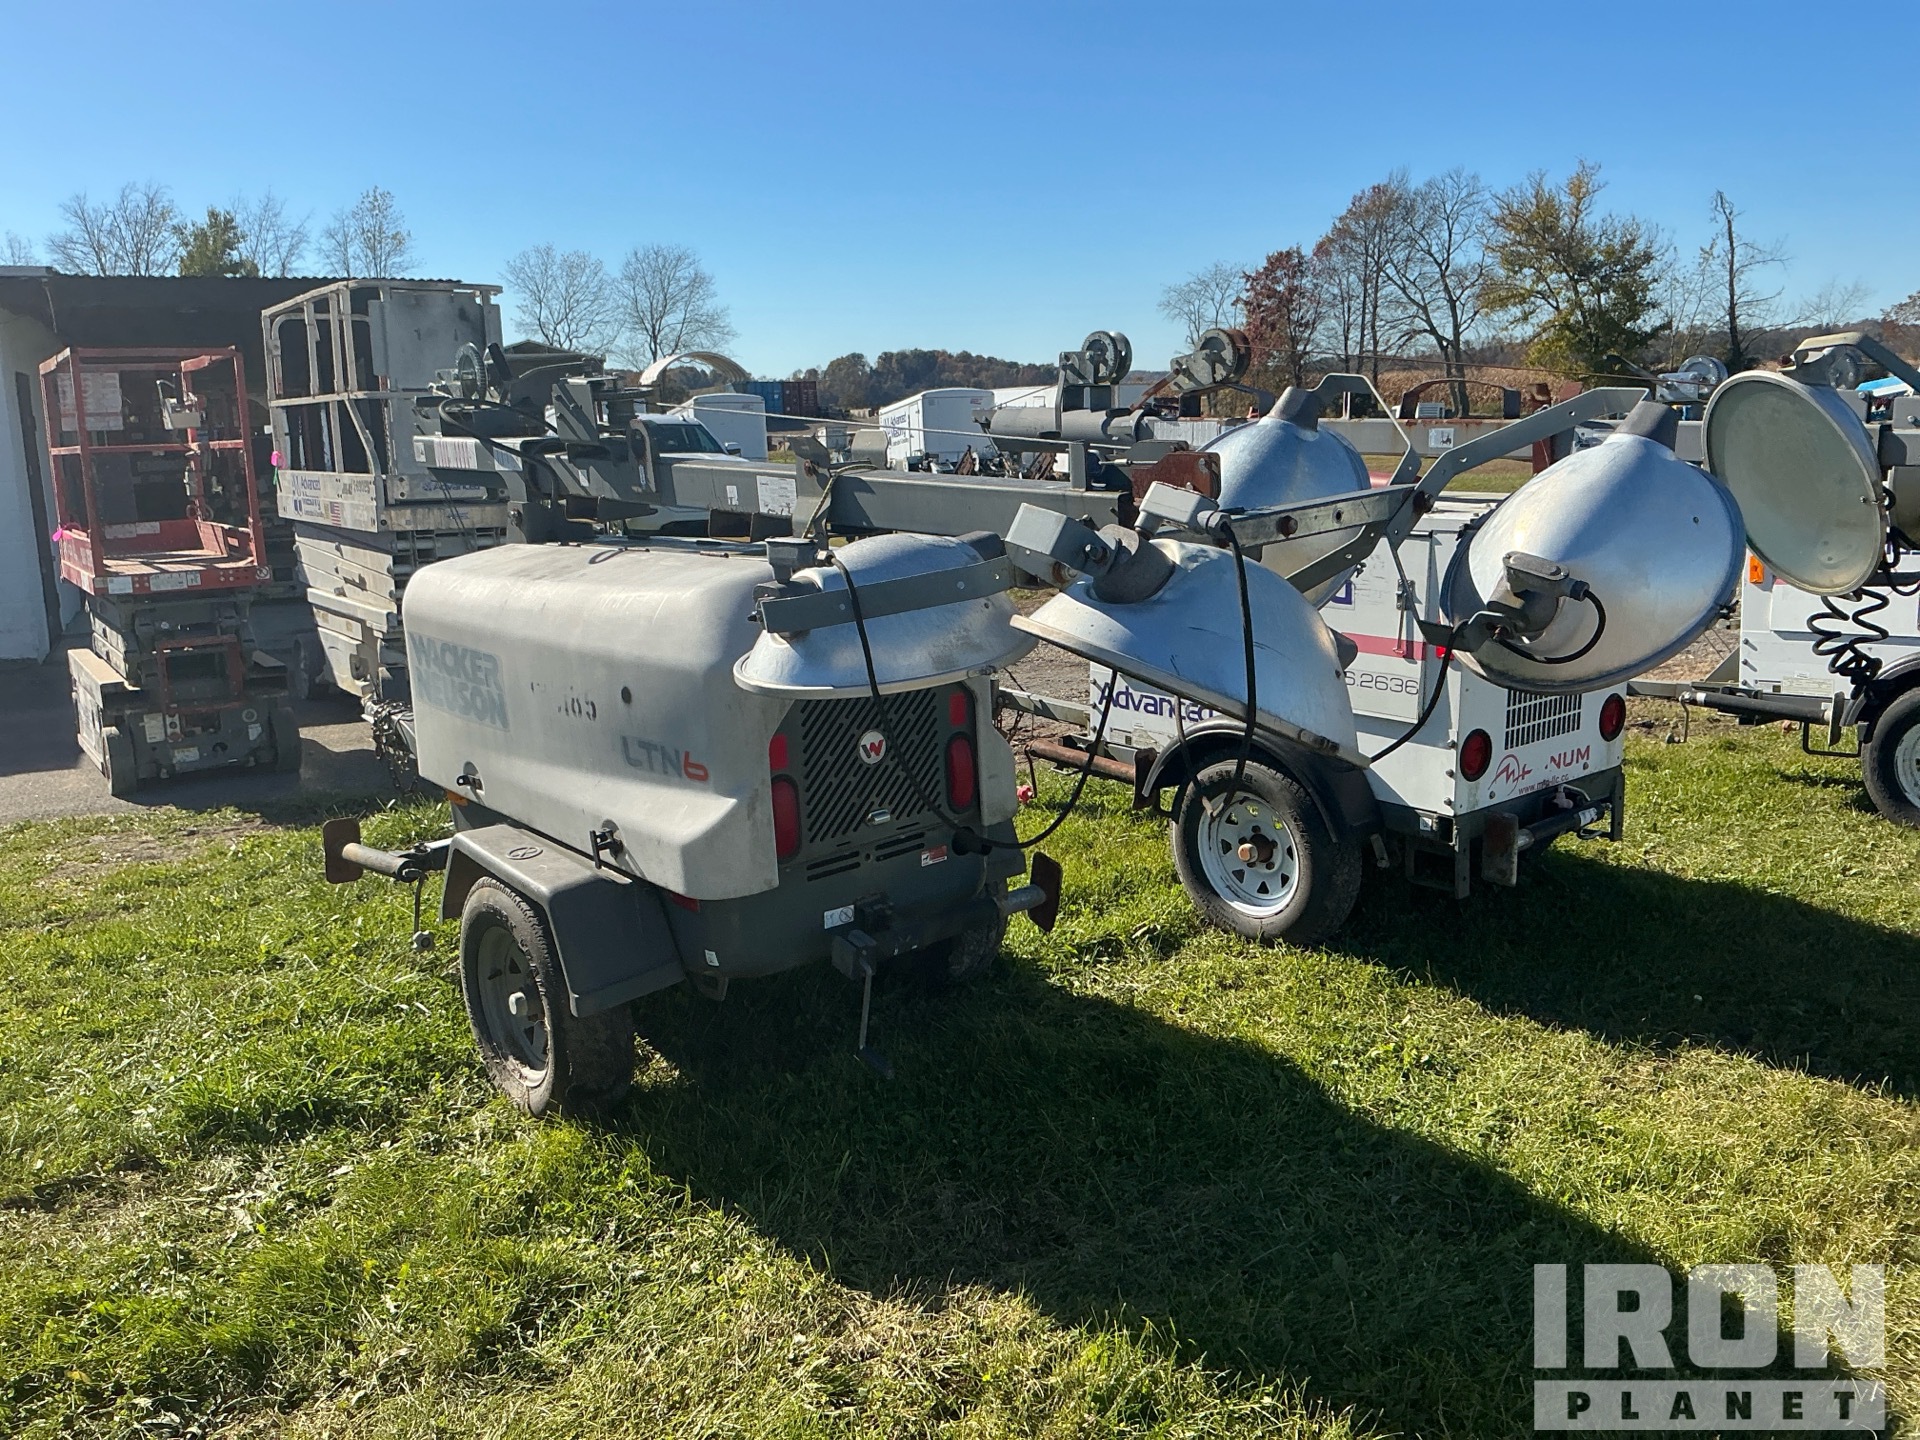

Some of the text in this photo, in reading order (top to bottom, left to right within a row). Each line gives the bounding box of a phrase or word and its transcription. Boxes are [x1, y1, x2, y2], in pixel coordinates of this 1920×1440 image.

[409, 632, 502, 692] WACKER
[415, 665, 510, 729] NEUSON
[620, 735, 709, 782] LTN6
